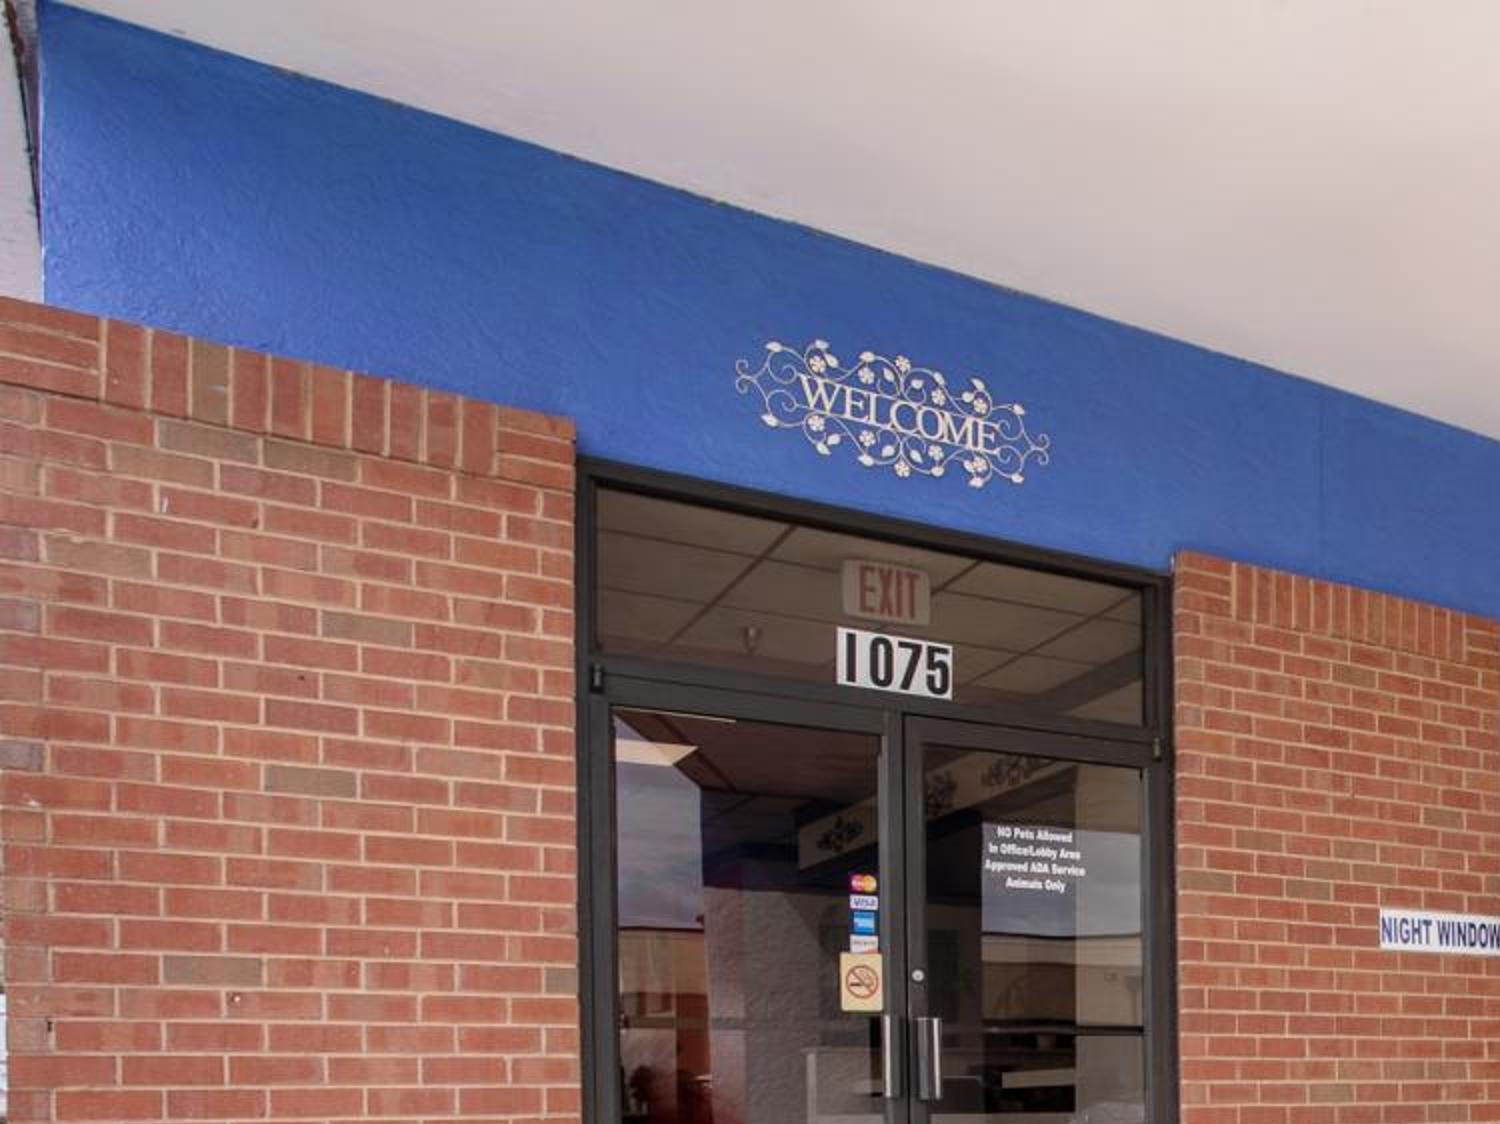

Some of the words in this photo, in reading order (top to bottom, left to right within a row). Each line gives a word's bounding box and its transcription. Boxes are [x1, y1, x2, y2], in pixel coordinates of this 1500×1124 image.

[797, 373, 1000, 454] WELCOME
[858, 565, 921, 619] EXIT
[845, 633, 950, 696] 1075
[1013, 827, 1035, 840] Pets
[1036, 829, 1073, 843] Allowed
[1059, 847, 1081, 860] Area
[985, 859, 1029, 873] Approved
[1030, 862, 1050, 873] ADA
[1051, 863, 1087, 877] Service
[1005, 876, 1043, 889] Animals
[1044, 879, 1066, 894] Only
[853, 896, 877, 907] VISA
[1379, 916, 1432, 945] NIGHT
